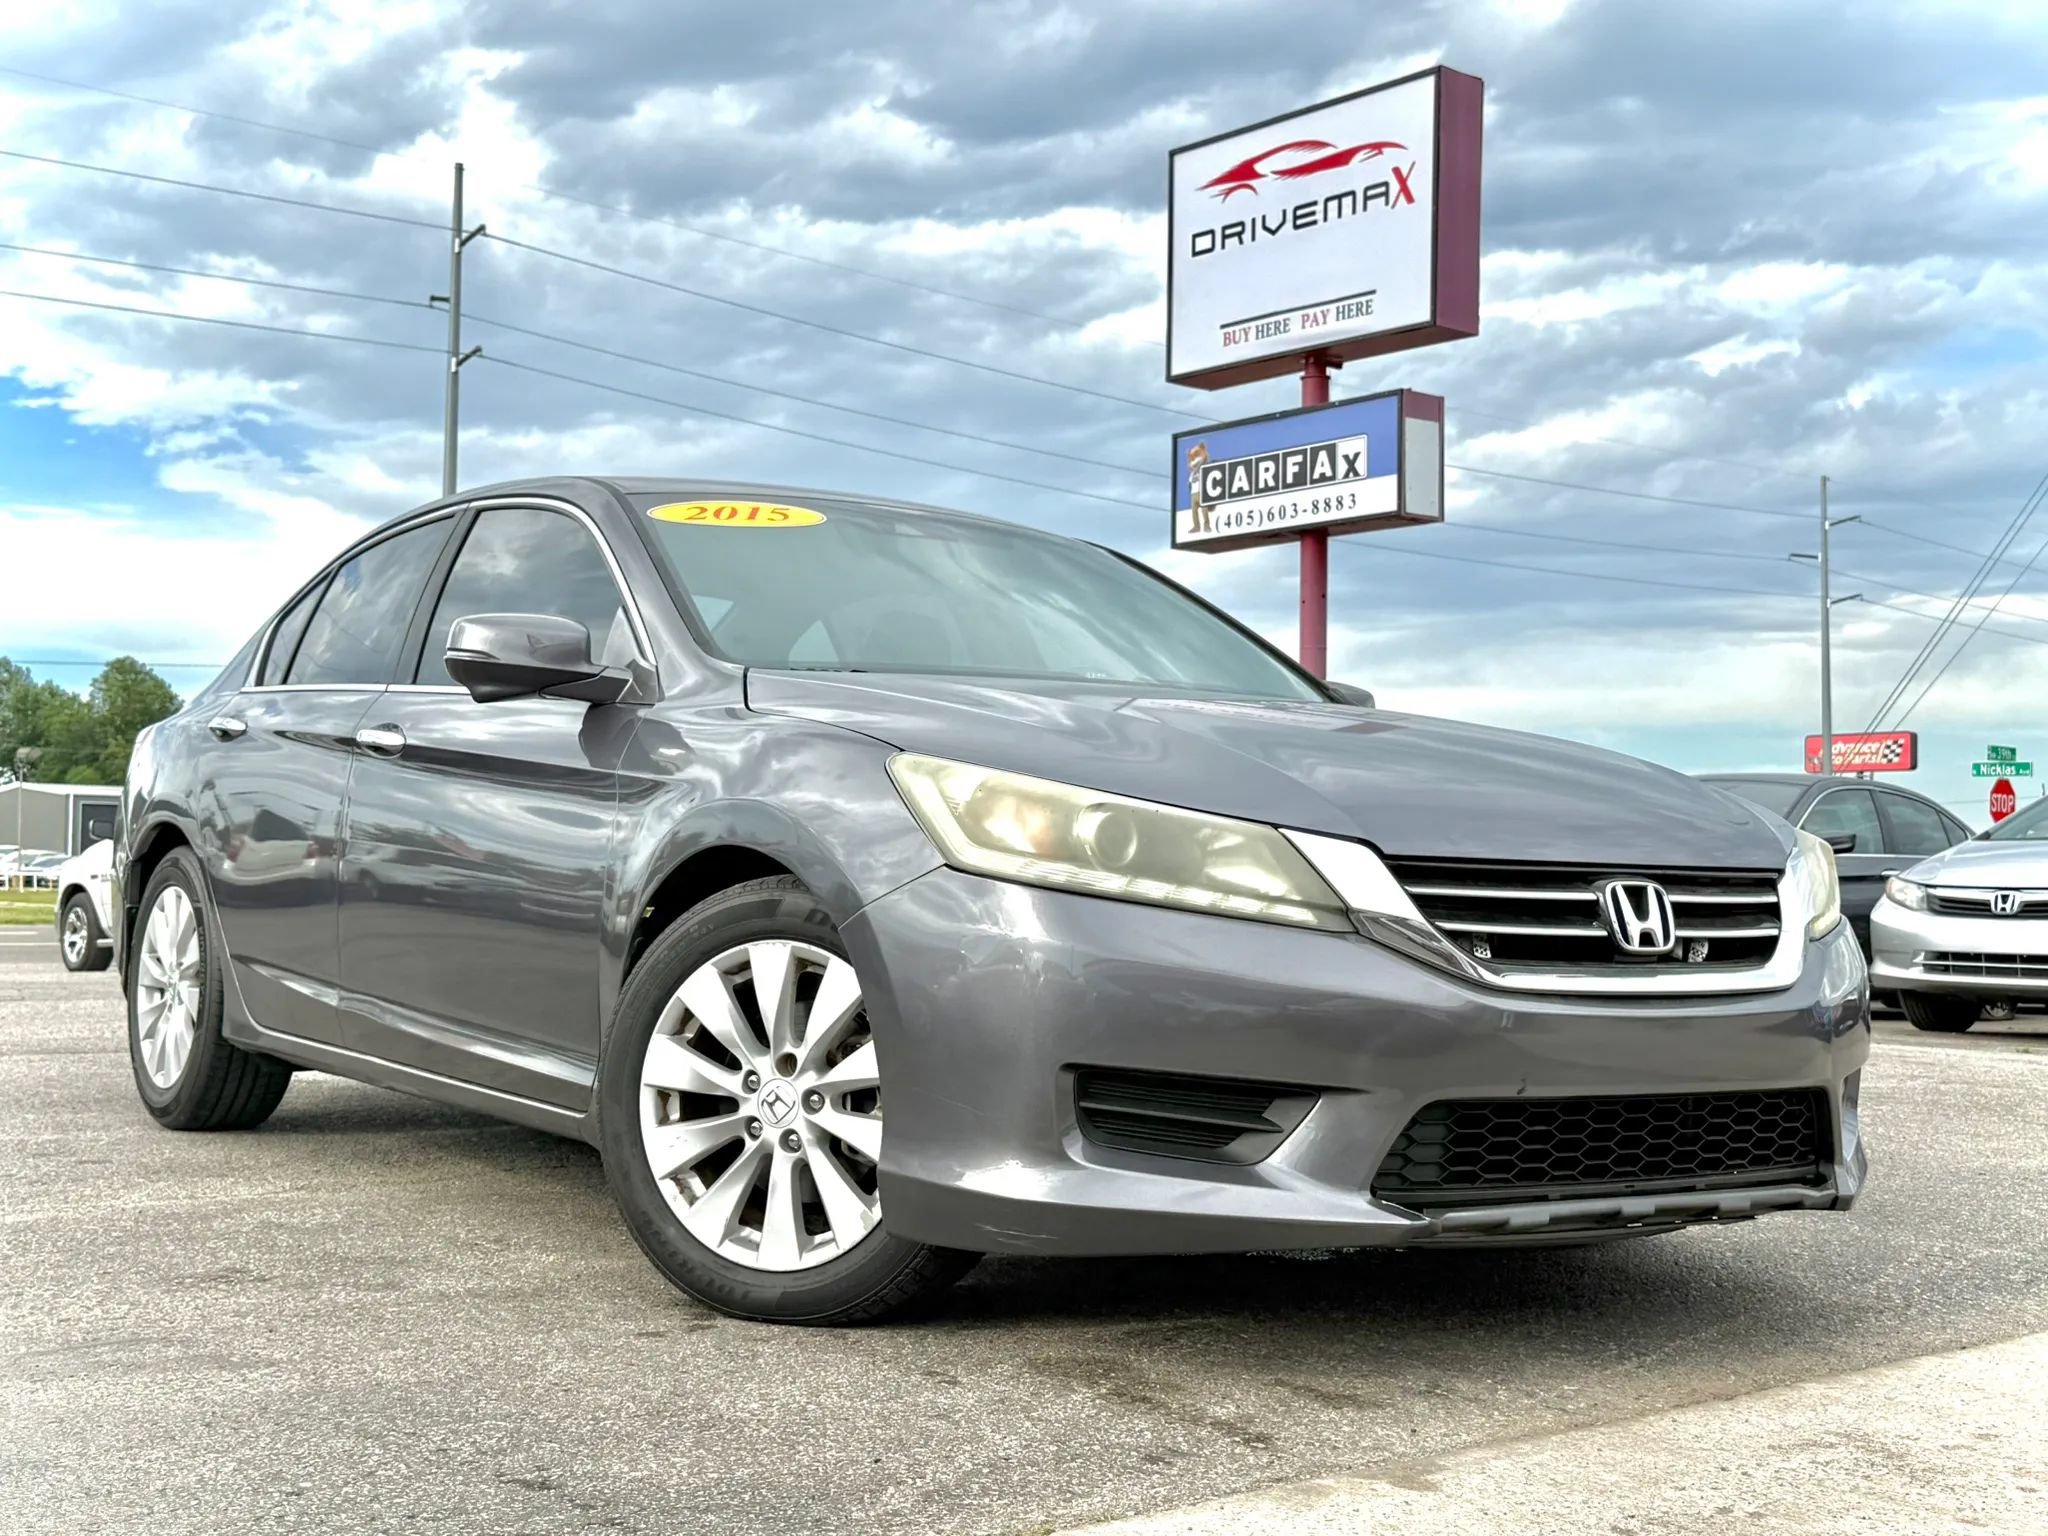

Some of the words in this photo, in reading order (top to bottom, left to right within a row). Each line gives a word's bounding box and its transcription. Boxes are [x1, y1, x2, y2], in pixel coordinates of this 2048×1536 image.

[1191, 161, 1416, 258] DRIVEMAX
[1222, 326, 1252, 347] BUY
[1255, 317, 1291, 340] HERE
[1300, 309, 1331, 329] PAY
[1335, 299, 1374, 321] HERE
[1204, 450, 1363, 498] CARFAX
[683, 505, 790, 522] 2015
[1215, 493, 1357, 533] (405)603-8883
[1980, 763, 2017, 775] Nicklas
[1991, 793, 2014, 813] STOP
